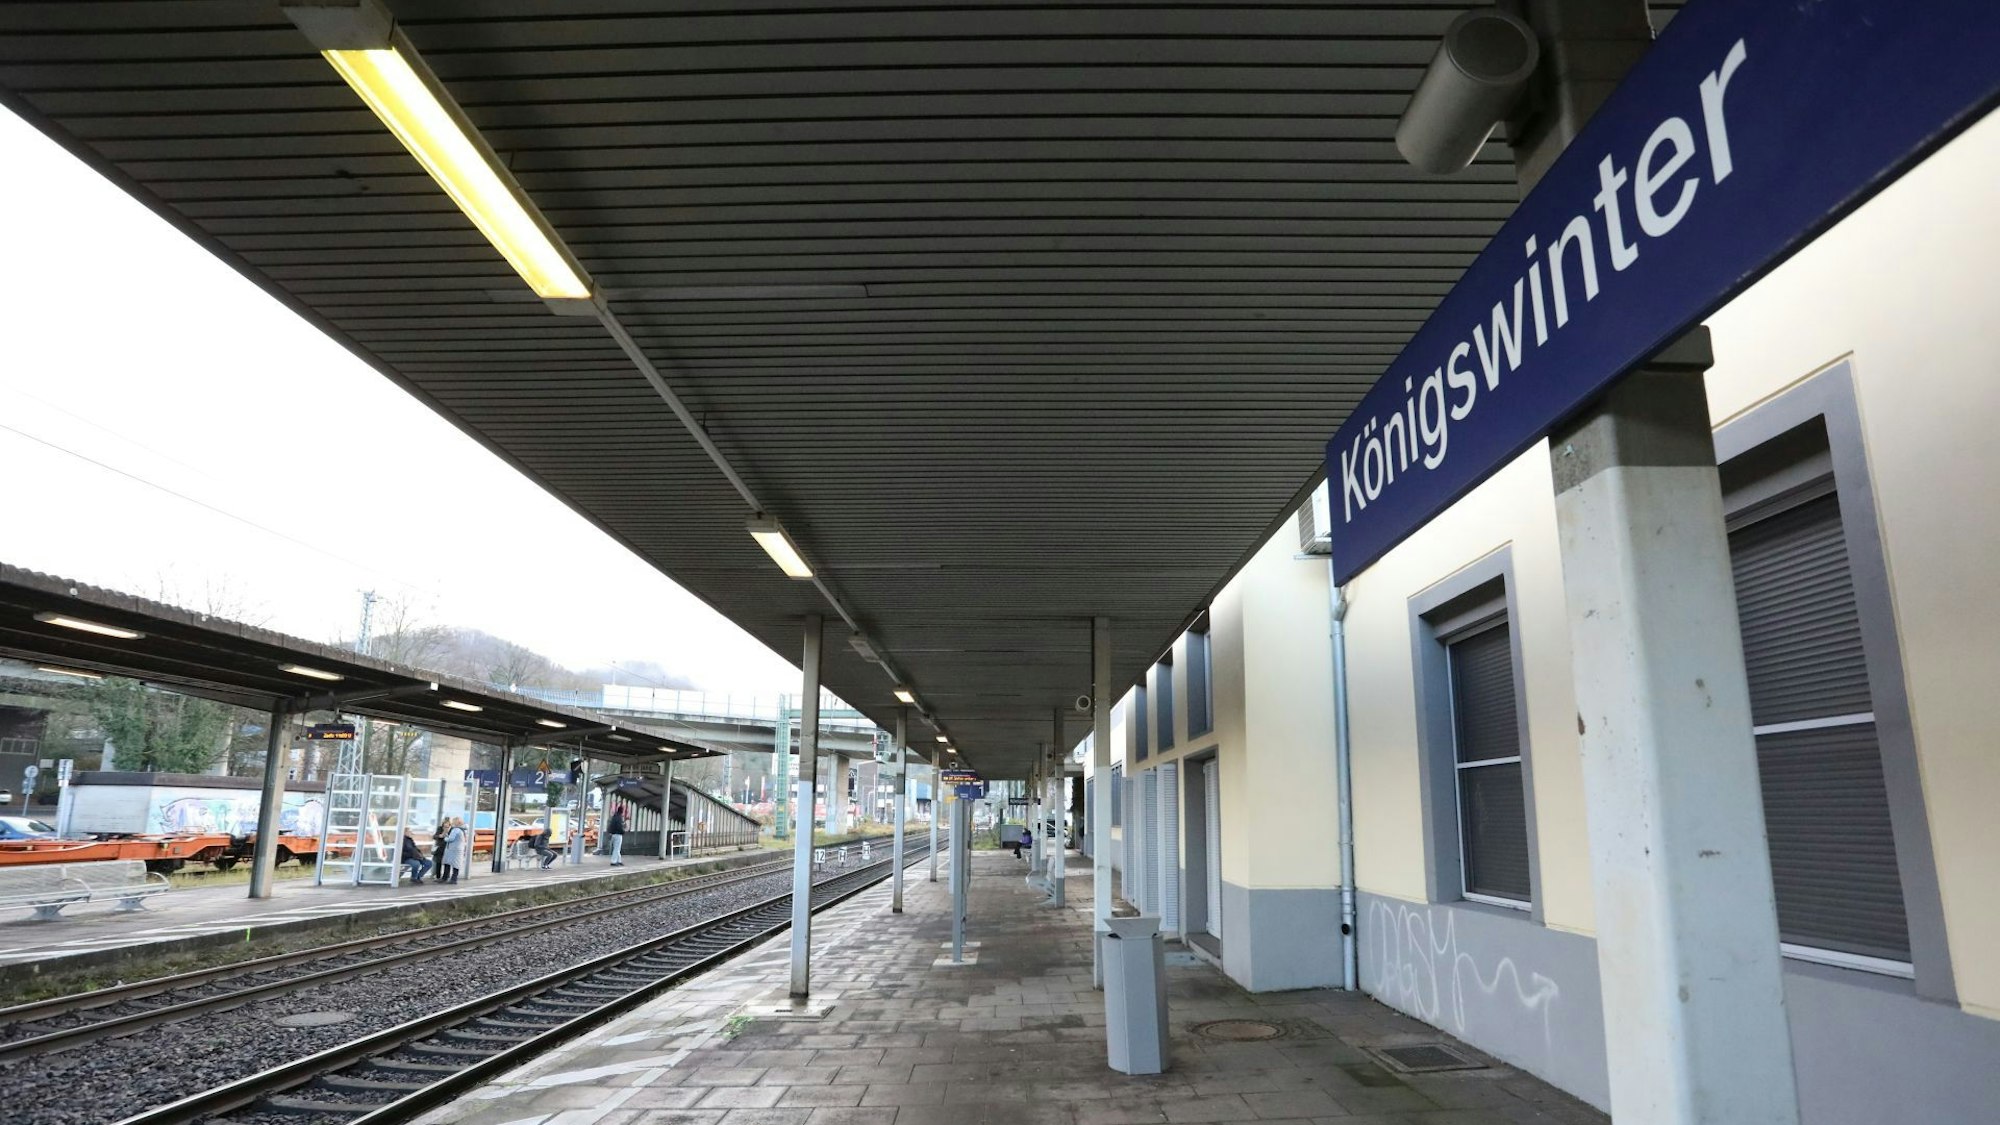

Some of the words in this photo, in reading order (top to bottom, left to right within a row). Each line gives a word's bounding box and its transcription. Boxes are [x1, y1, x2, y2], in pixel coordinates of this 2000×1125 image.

[1341, 37, 1747, 523] Königswinter
[466, 771, 474, 782] 4
[535, 771, 545, 784] 2
[978, 786, 984, 797] 1
[816, 850, 825, 861] 12
[840, 850, 846, 861] H
